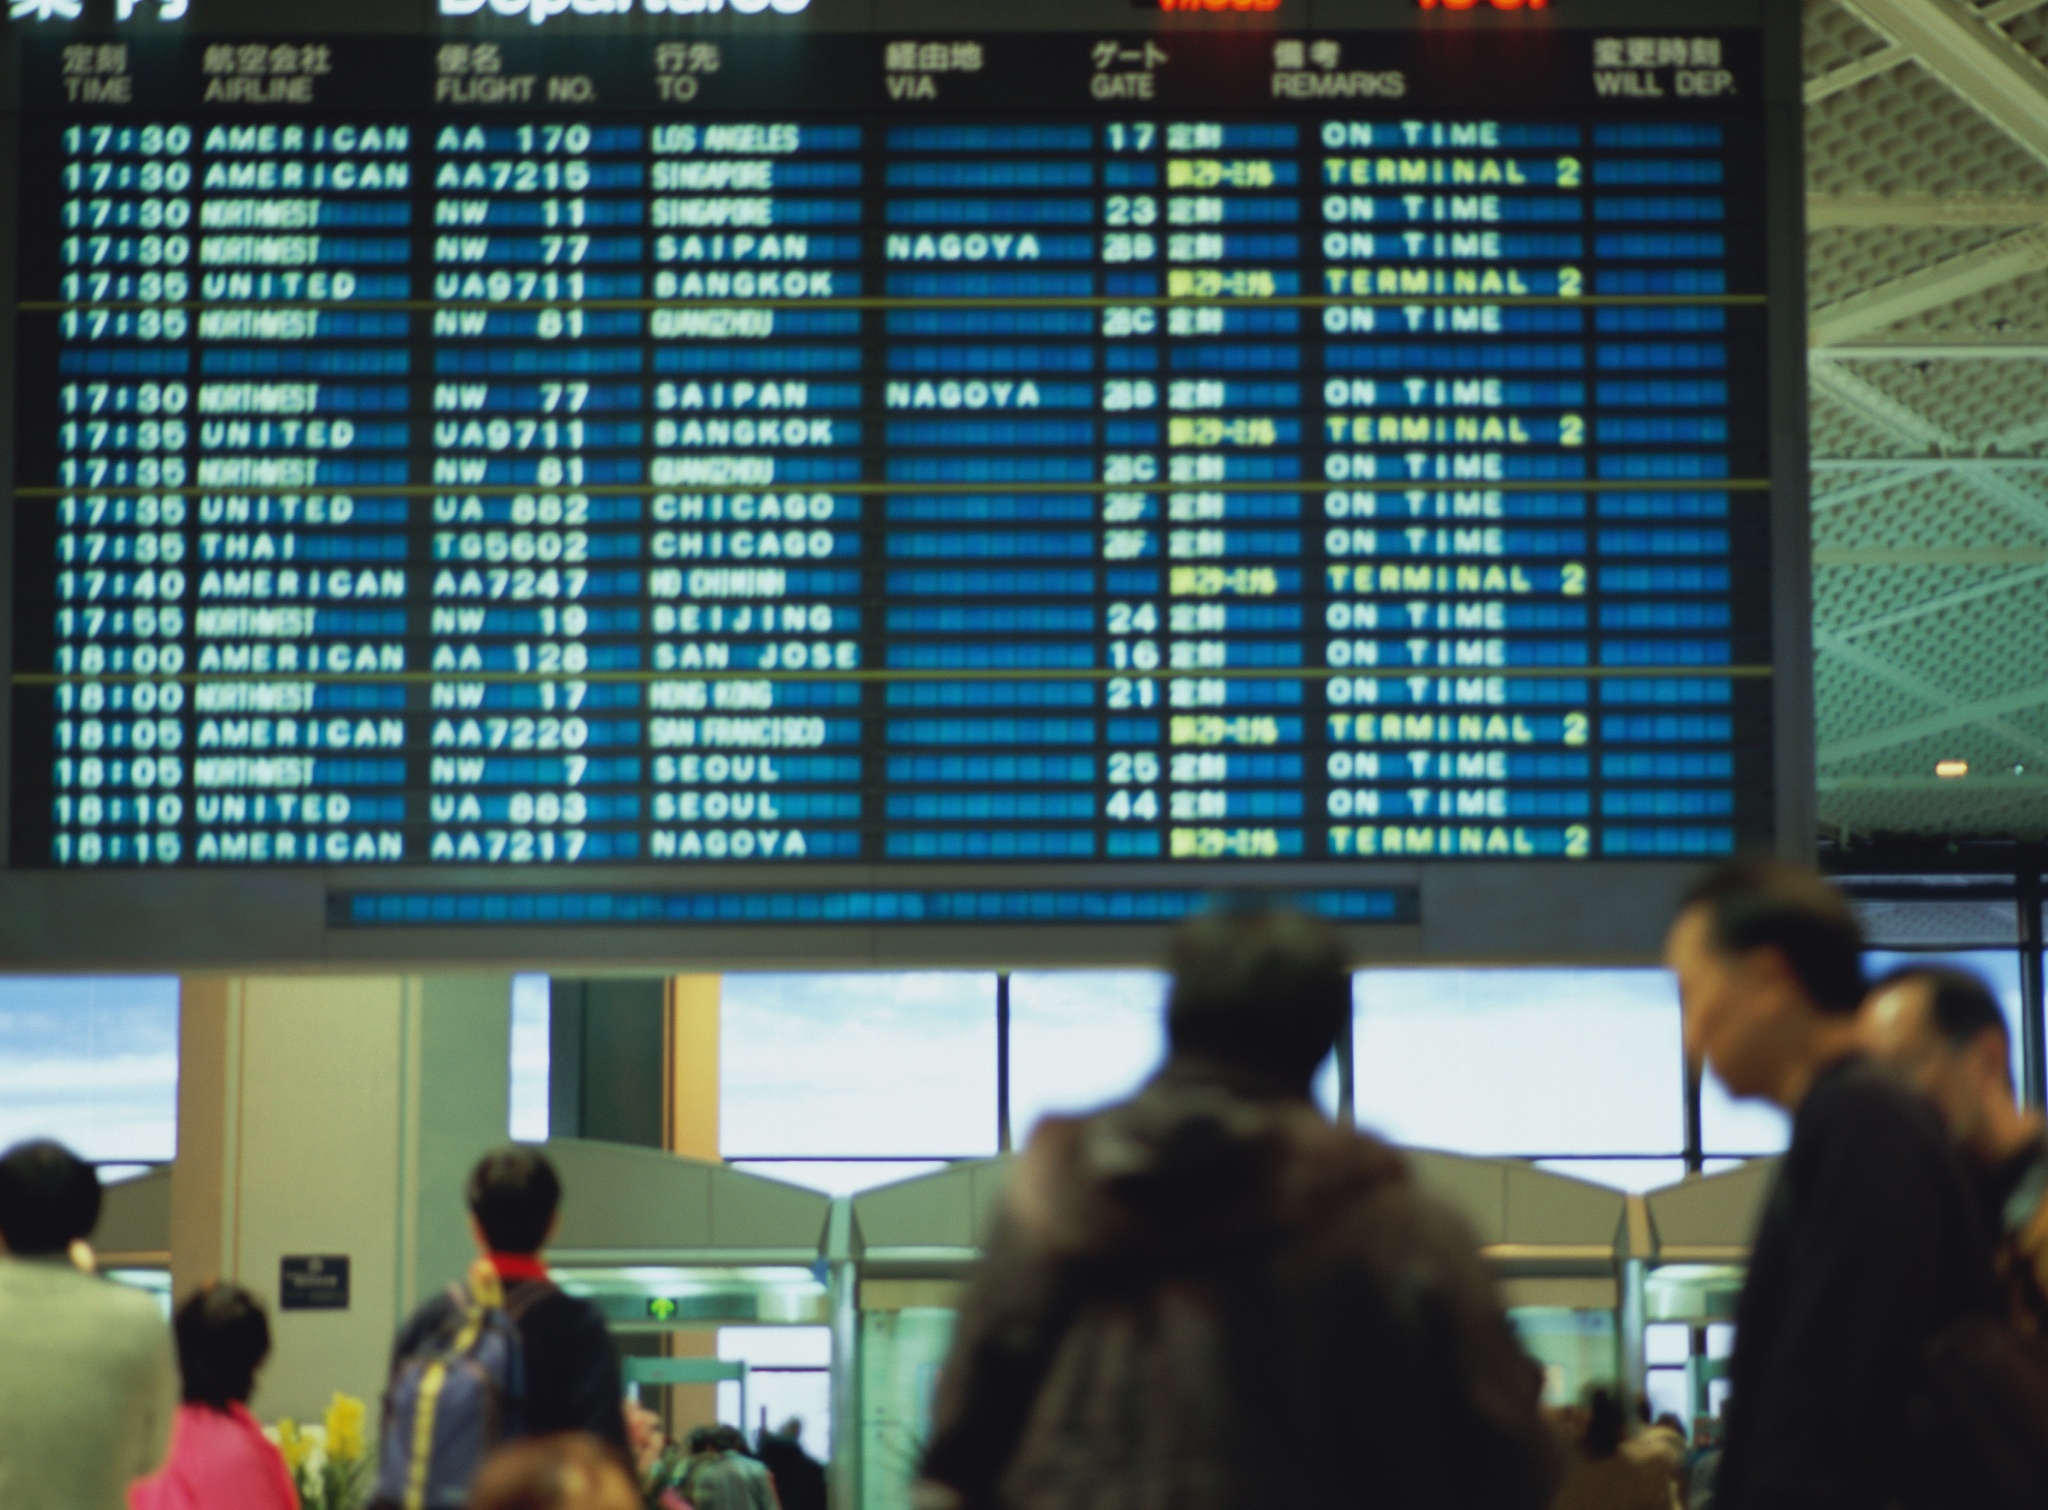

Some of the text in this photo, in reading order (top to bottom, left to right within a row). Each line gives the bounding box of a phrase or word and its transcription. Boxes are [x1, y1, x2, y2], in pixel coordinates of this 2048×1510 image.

[63, 44, 128, 74] 定刻
[204, 44, 331, 75] 航空会社
[656, 43, 720, 73] 行先
[1092, 41, 1168, 71] ゲート
[64, 76, 132, 103] TIME
[204, 76, 313, 102] AIRLINE
[435, 76, 596, 102] FLIGHT NO.
[657, 75, 698, 101] TO
[886, 75, 937, 100] VIA
[1091, 73, 1155, 99] GATE
[1272, 71, 1404, 98] REMARKS
[1594, 71, 1737, 96] WILL DEP.
[66, 126, 191, 153] 17:30
[205, 126, 408, 152] AMERICAN
[438, 125, 591, 153] AA 170
[652, 124, 799, 152] LOS ANGELES
[1111, 124, 1154, 150] 17
[1322, 121, 1495, 147] ON TIME
[65, 162, 191, 191] 17:30
[205, 162, 408, 189] AMERICAN
[437, 161, 590, 191] AA7215
[652, 160, 771, 190] SINGAPORE
[1326, 157, 1580, 187] TERMINAL 2
[64, 199, 190, 228] 17:30
[436, 198, 586, 227] NW 11
[652, 197, 771, 227] SINGAPORE
[1107, 196, 1157, 226] 23
[1323, 194, 1498, 221] ON TIME
[64, 236, 190, 264] 17:30
[435, 234, 590, 264] NW 77
[657, 233, 808, 261] SAIPAN
[887, 233, 1039, 260] NAGOYA
[1323, 231, 1499, 258] ON TIME
[63, 272, 188, 301] 17:35
[203, 272, 356, 300] UNITED
[655, 270, 832, 298] BANGKOK
[1327, 267, 1582, 299] TERMINAL 2
[62, 309, 187, 338] 17:35
[434, 310, 487, 335] NW
[1323, 304, 1500, 332] ON TIME
[61, 383, 188, 413] 17:30
[434, 382, 590, 413] NW 77
[656, 381, 808, 410] SAIPAN
[886, 381, 1040, 409] NAGOYA
[1323, 378, 1500, 406] ON TIME
[61, 420, 186, 450] 17:35
[201, 420, 355, 449] UNITED
[654, 418, 832, 446] BANGKOK
[1327, 414, 1584, 446] TERMINAL 2
[60, 458, 186, 487] 17:35
[434, 458, 487, 484] NW
[1324, 452, 1501, 480] ON TIME
[59, 494, 185, 525] 17:35
[200, 494, 354, 523] UNITED
[434, 495, 484, 521] UA
[652, 492, 835, 521] CHICAGO
[1324, 489, 1501, 518] ON TIME
[58, 532, 184, 562] 17:35
[203, 532, 295, 559] THAI
[651, 529, 834, 558] CHICAGO
[1324, 527, 1502, 555] ON TIME
[58, 569, 186, 600] 17:40
[200, 569, 405, 598] AMERICAN
[433, 568, 589, 601] AA7247
[1328, 563, 1586, 596] TERMINAL 2
[57, 607, 183, 636] 17:55
[431, 608, 485, 633] NW
[652, 604, 833, 633] BEIJING
[1108, 602, 1157, 635] 24
[1325, 601, 1504, 630] ON TIME
[57, 644, 185, 674] 18:00
[199, 644, 405, 673] AMERICAN
[433, 644, 482, 670] AA
[655, 641, 855, 670] SAN JOSE
[1111, 640, 1160, 673] 16
[1326, 638, 1504, 667] ON TIME
[56, 681, 184, 712] 18:00
[431, 678, 588, 711] NW 17
[1108, 676, 1155, 709] 21
[1326, 675, 1504, 704] ON TIME
[56, 719, 182, 749] 18:05
[198, 719, 404, 748] AMERICAN
[432, 716, 589, 751] AA7220
[649, 717, 696, 748] SAN
[1329, 712, 1588, 746] TERMINAL 2
[55, 756, 185, 787] 18:05
[431, 754, 588, 786] NW 7
[654, 754, 778, 783] SEOUL
[1108, 752, 1159, 784] 25
[1326, 750, 1505, 779] ON TIME
[55, 794, 183, 824] 18:10
[196, 793, 351, 823] UNITED
[431, 794, 482, 822] UA
[654, 791, 778, 820] SEOUL
[1105, 789, 1158, 820] 44
[1327, 788, 1506, 817] ON TIME
[54, 833, 179, 860] 18:15
[198, 831, 403, 860] AMERICAN
[431, 829, 587, 863] AA7217
[651, 829, 807, 857] NAGOYA
[1330, 825, 1589, 857] TERMINAL 2
